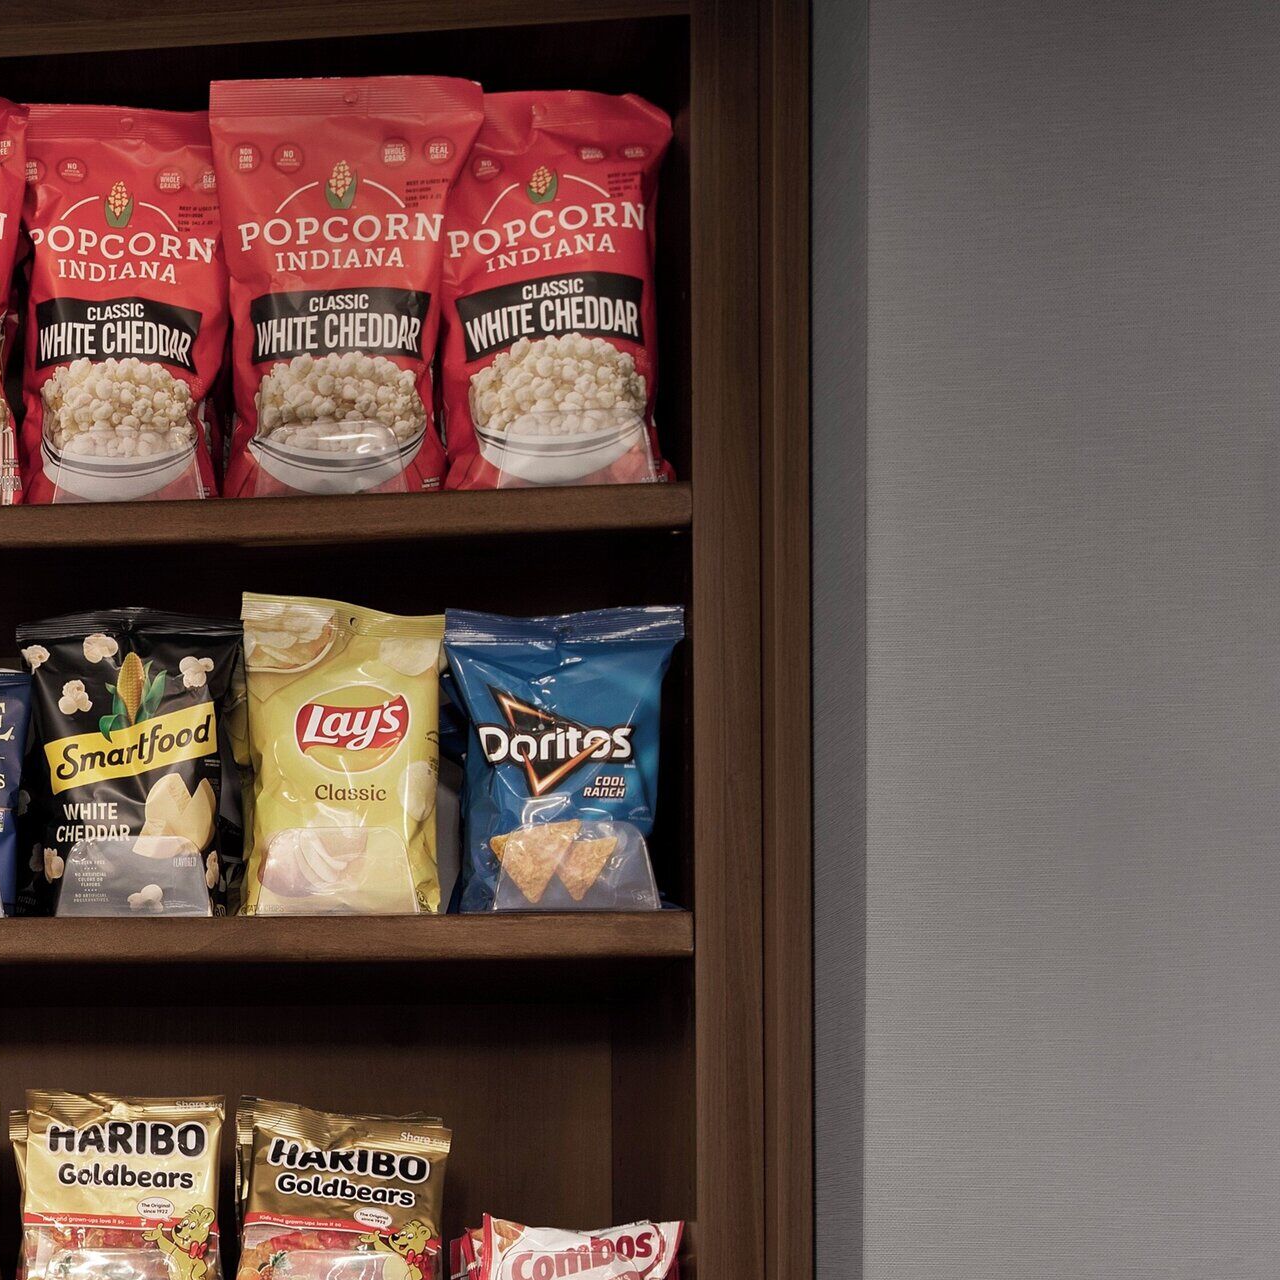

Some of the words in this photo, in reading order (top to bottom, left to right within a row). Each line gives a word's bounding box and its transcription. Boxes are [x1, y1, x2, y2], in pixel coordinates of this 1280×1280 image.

[429, 146, 448, 154] REAL
[29, 225, 216, 263] POPCORN
[238, 214, 444, 252] POPCORN
[447, 201, 645, 258] POPCORN
[276, 247, 404, 271] INDIANA
[486, 233, 616, 273] INDIANA
[58, 259, 177, 285] INDIANA
[309, 294, 369, 313] CLASSIC
[522, 278, 584, 301] CLASSIC
[87, 303, 145, 321] CLASSIC
[466, 301, 534, 353] WHITE
[540, 296, 638, 337] CHEDDAR
[40, 322, 96, 362] WHITE
[102, 322, 192, 365] CHEDDAR
[257, 316, 318, 356] WHITE
[325, 313, 421, 353] CHEDDAR
[302, 702, 403, 751] Lay's
[56, 714, 211, 781] Smartfood
[478, 726, 632, 764] Doritos
[315, 784, 387, 801] Classic
[583, 787, 625, 798] RANCH
[595, 776, 625, 786] COOL
[63, 803, 118, 821] WHITE
[56, 824, 131, 842] CHEDDAR
[48, 1122, 205, 1157] HARIBO
[271, 1138, 426, 1181] HARIBO
[59, 1163, 193, 1188] Goldbears
[278, 1175, 413, 1206] Goldbears
